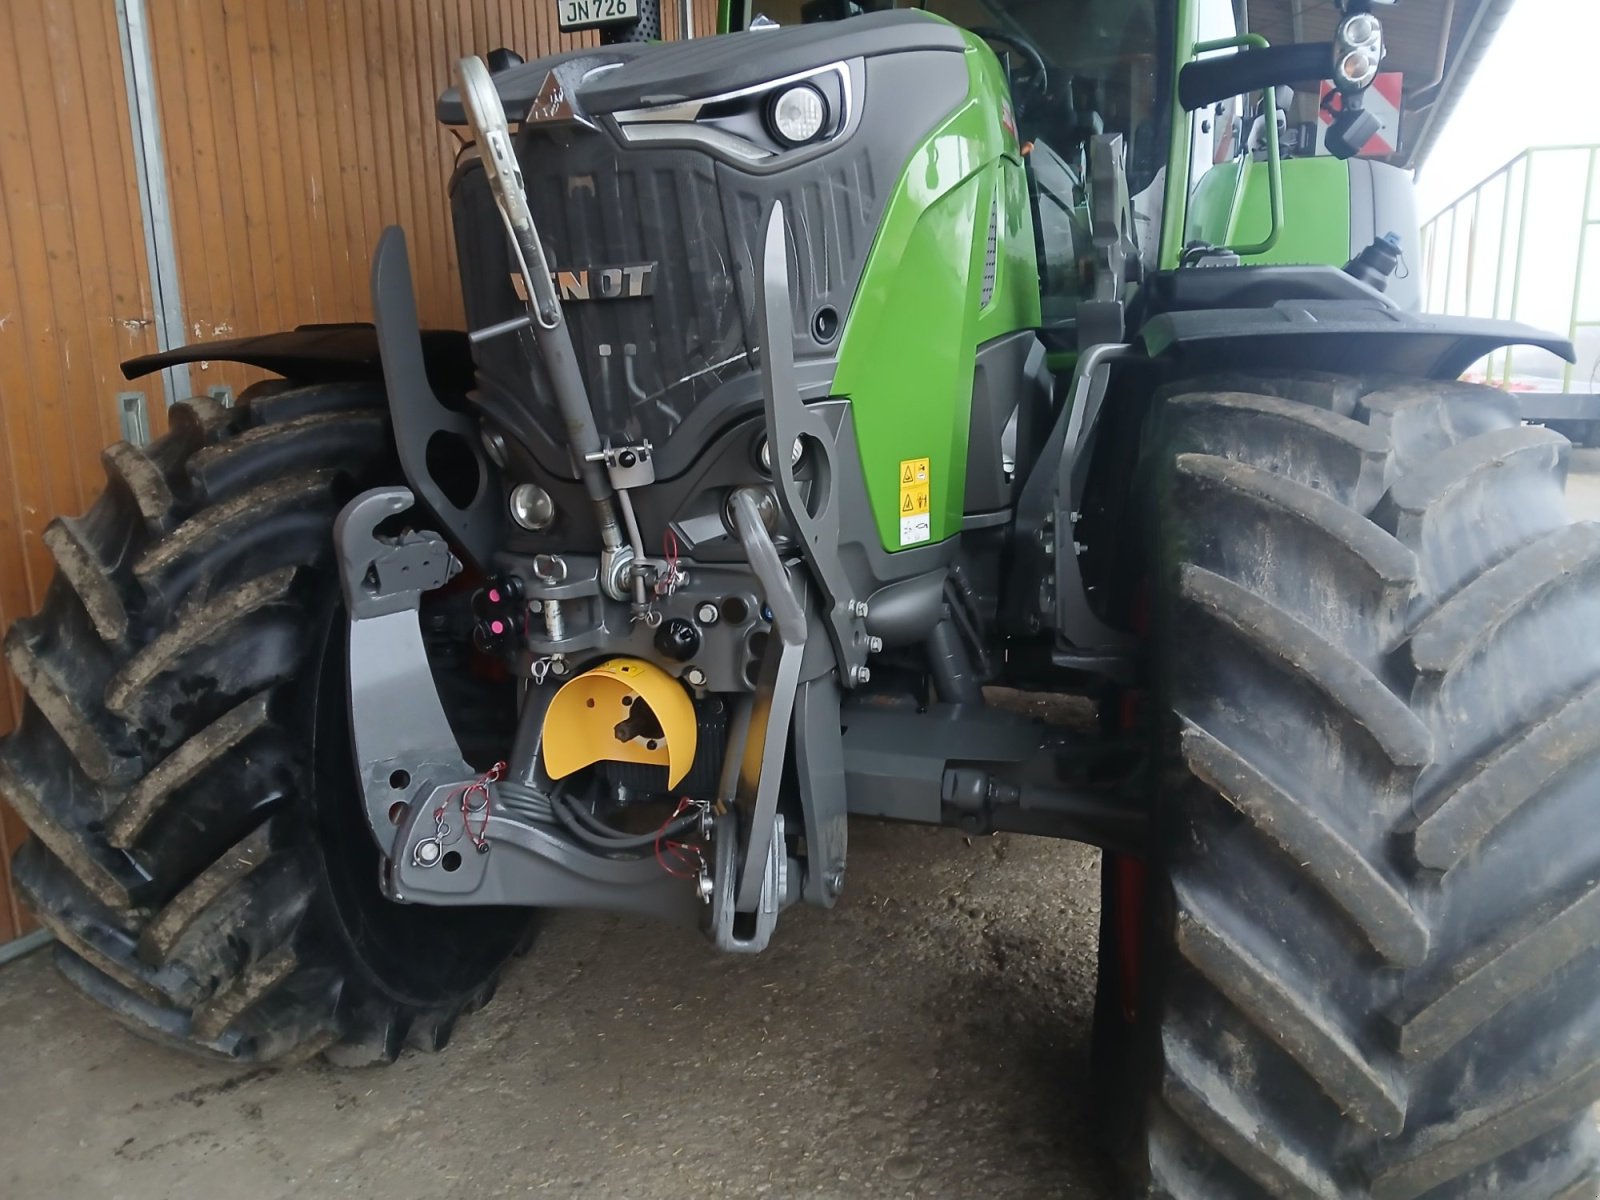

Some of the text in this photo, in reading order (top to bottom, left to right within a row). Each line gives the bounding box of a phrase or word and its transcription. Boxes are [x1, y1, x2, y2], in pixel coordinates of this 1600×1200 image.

[567, 0, 627, 22] JN 726
[510, 265, 653, 301] FNDT
